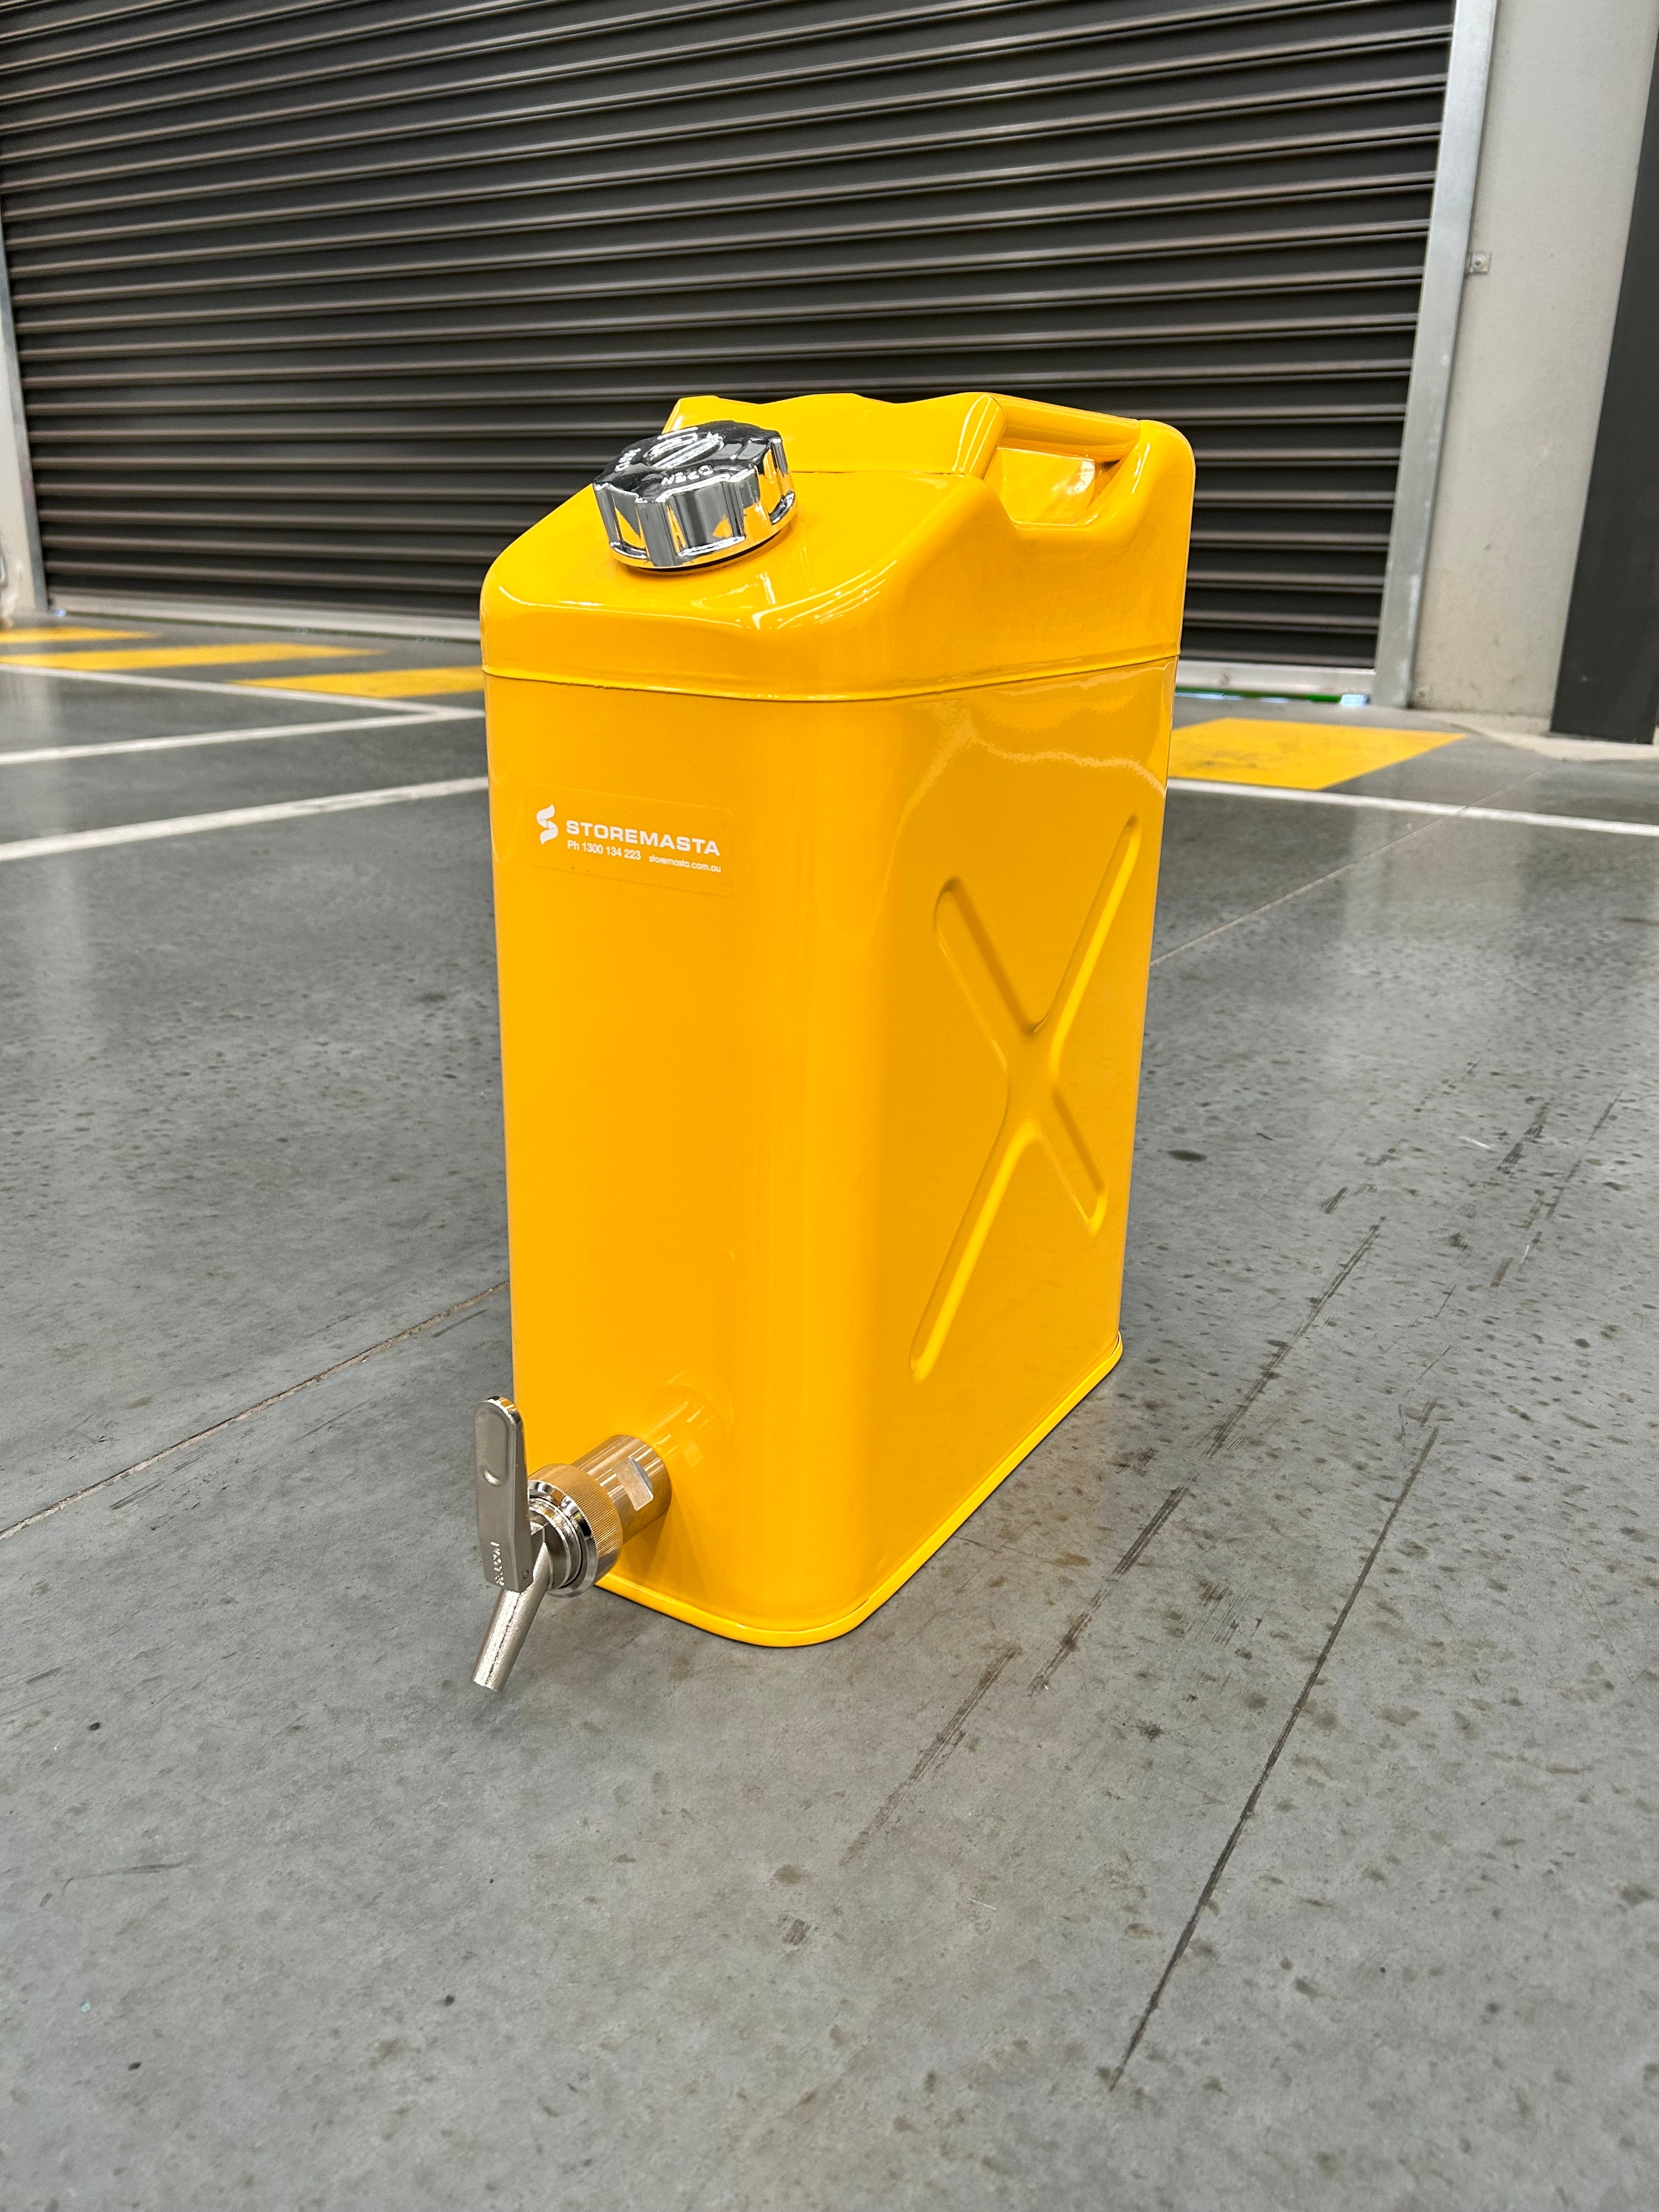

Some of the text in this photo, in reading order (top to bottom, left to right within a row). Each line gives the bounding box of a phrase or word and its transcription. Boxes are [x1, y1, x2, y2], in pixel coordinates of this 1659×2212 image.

[566, 820, 720, 856] STOREMASTA
[567, 840, 721, 873] Ph 1300 134 223 storemasta.com.au
